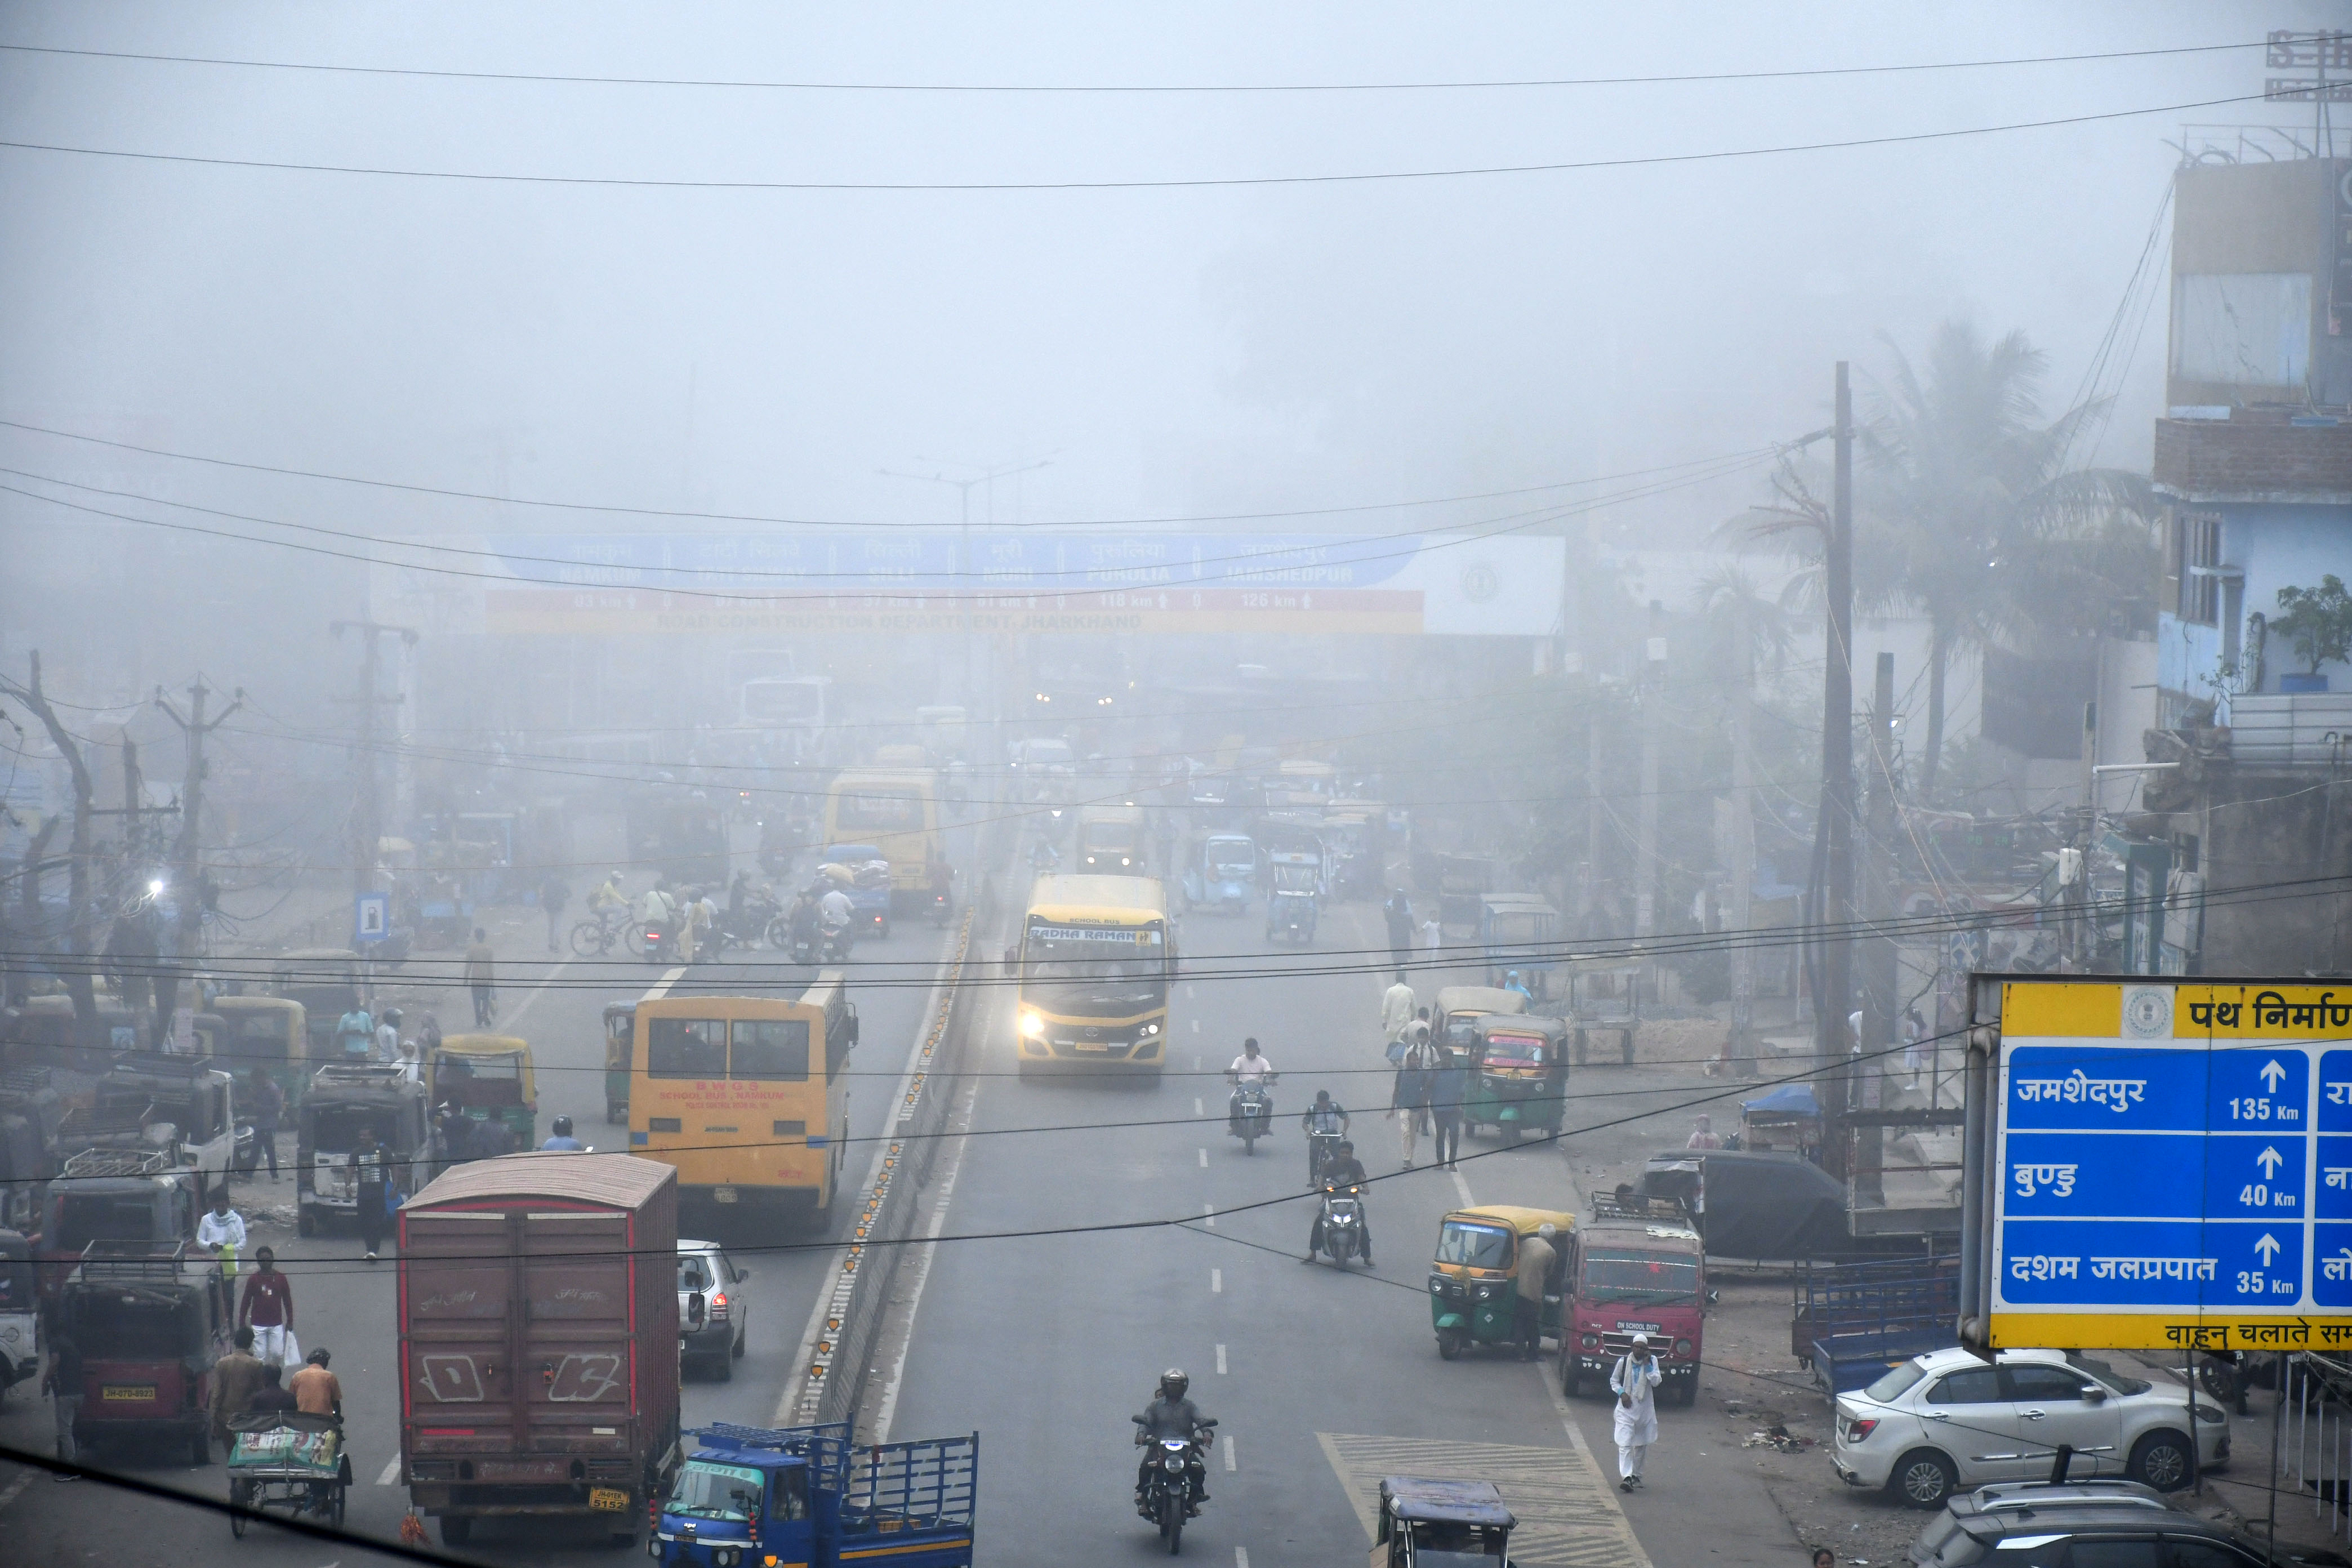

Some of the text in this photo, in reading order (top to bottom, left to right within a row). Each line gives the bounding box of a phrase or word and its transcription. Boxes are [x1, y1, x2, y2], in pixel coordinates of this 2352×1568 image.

[983, 567, 1034, 582] MURI
[1086, 567, 1170, 582] PURULIA
[1223, 567, 1353, 582] JAMSHEDPUR
[1100, 593, 1153, 607] 118 km
[1242, 593, 1296, 607] 126 km
[716, 614, 872, 629] CONSTRUCTION
[1022, 614, 1142, 629] JHARKHAND
[1031, 929, 1136, 941] RADHA RAMAN
[2190, 1001, 2243, 1028] पथ
[2016, 1069, 2147, 1112] जमशेदपुर
[2229, 1097, 2300, 1120] 135 Km
[2239, 1184, 2296, 1207] 40 Km
[2010, 1256, 2219, 1281] दशम जलप्रपात
[2237, 1271, 2294, 1294] 35 Km
[2238, 1317, 2312, 1344] चलाते
[598, 1490, 622, 1499] JH-01EK
[594, 1499, 624, 1510] 5152
